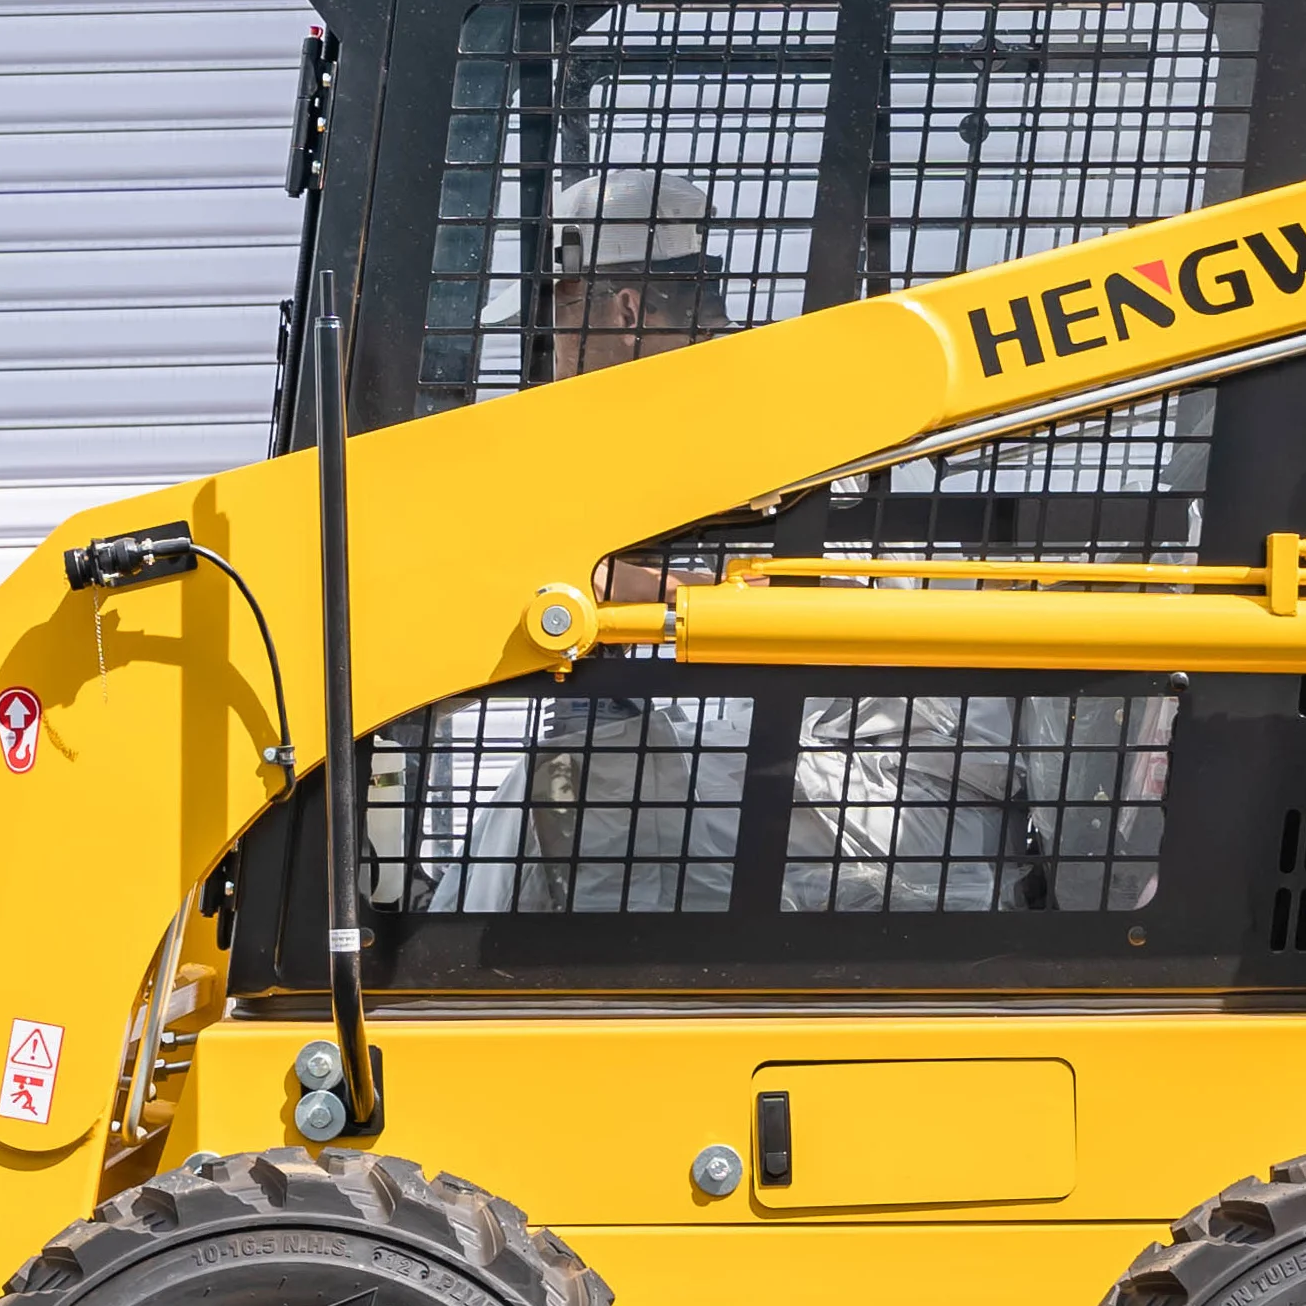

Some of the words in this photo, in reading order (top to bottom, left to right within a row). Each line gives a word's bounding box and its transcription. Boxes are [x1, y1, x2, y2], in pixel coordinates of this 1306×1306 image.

[194, 1235, 278, 1267] 10-16.5
[282, 1232, 353, 1259] N.H.S.
[384, 1250, 412, 1277] 12
